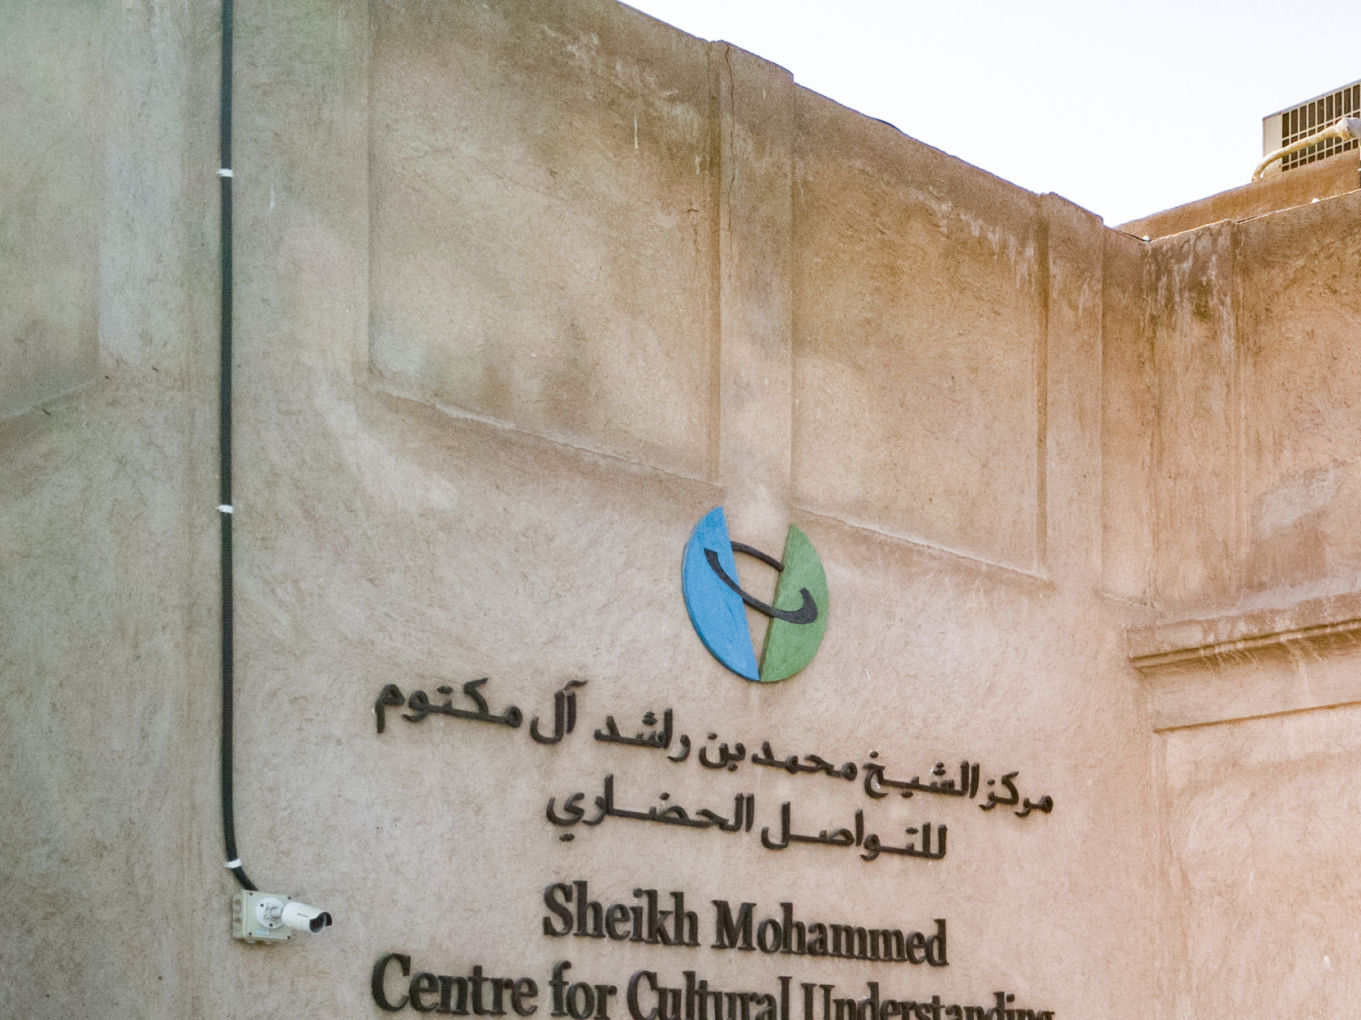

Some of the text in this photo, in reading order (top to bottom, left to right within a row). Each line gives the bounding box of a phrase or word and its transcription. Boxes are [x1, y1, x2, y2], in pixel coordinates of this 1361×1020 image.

[374, 677, 1053, 818] مركز الشيخ محمد بن راشد آل مكتوم
[545, 773, 947, 862] للتواصل الحضاري
[542, 880, 950, 968] Sheikh Mohammed
[370, 952, 540, 1018] Centre
